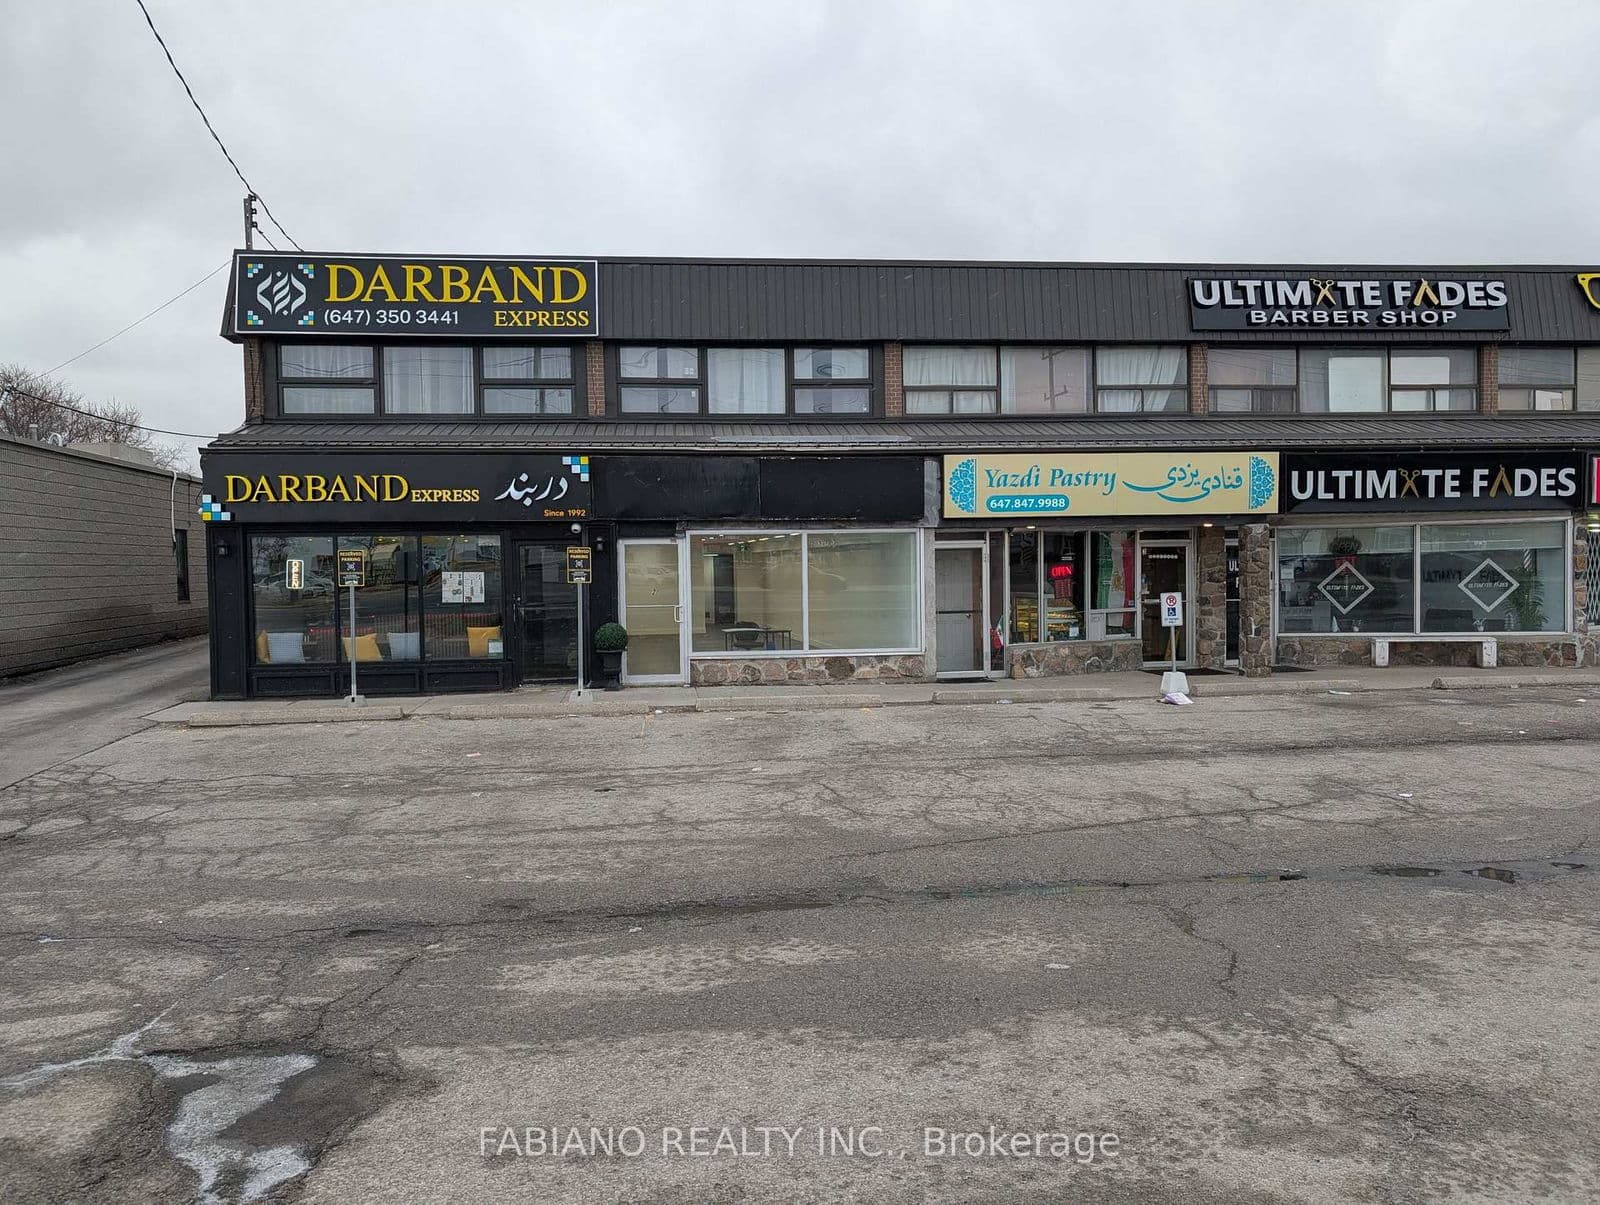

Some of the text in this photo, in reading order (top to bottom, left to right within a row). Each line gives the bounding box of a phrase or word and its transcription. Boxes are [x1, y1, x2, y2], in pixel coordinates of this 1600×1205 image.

[324, 264, 588, 304] DARBAND
[1393, 278, 1508, 307] FADES
[324, 309, 459, 326] (647) 350 3441
[493, 310, 590, 327] EXPRESS
[1250, 310, 1458, 324] BARBER SHOP
[224, 474, 481, 503] DARBAND EXPRESS
[494, 473, 569, 507] دربند
[984, 464, 1118, 496] Yazdi Pastry
[1472, 464, 1577, 498] FADES
[543, 509, 586, 517] Since 1992
[989, 498, 1067, 509] 647.847.9988
[292, 561, 300, 588] OPEN
[1051, 566, 1073, 577] OPEN
